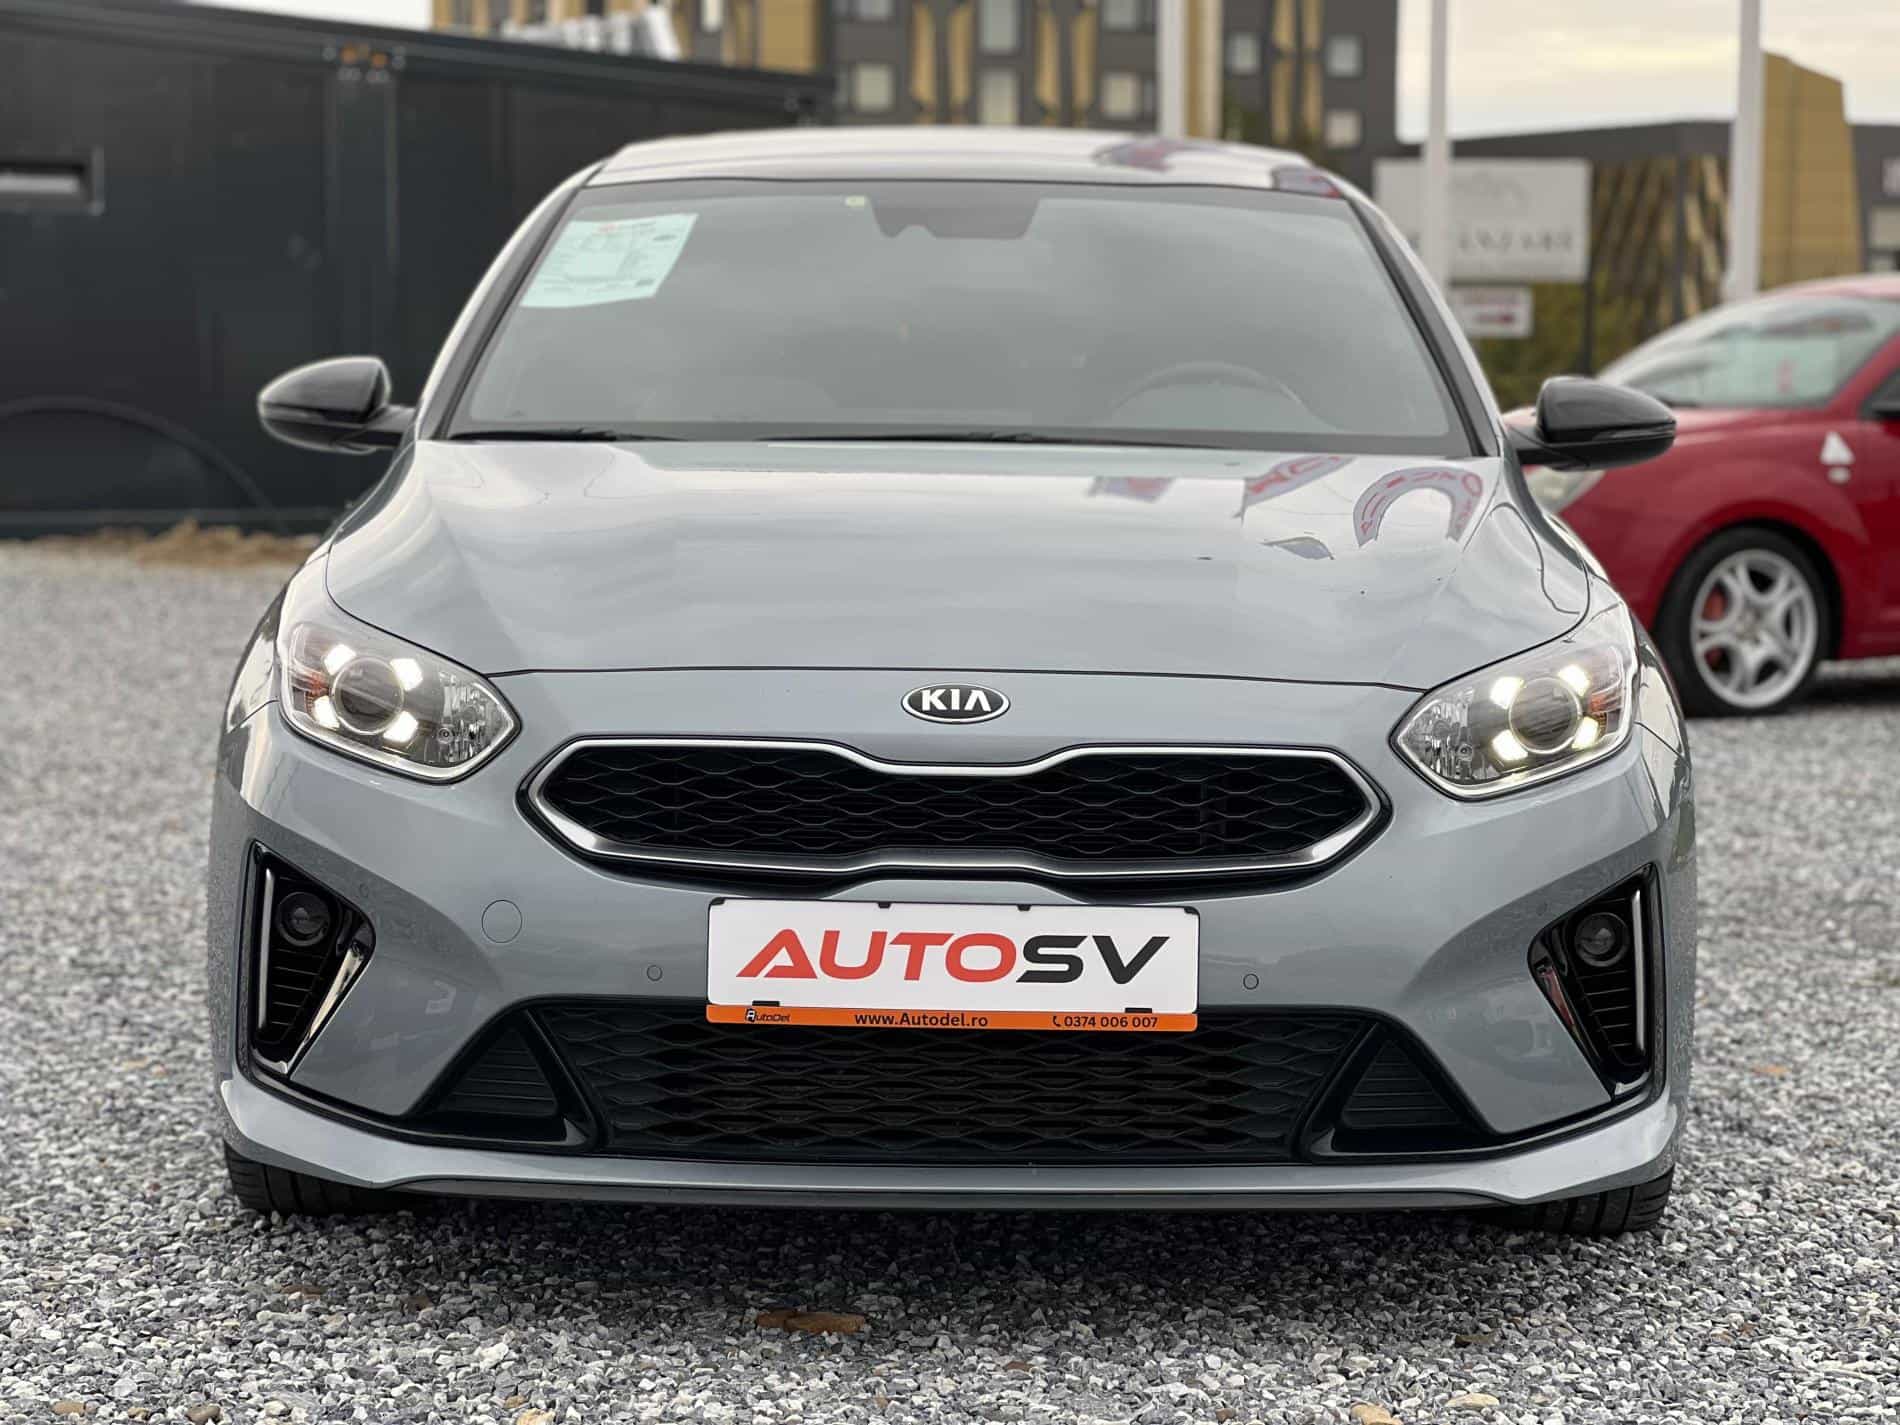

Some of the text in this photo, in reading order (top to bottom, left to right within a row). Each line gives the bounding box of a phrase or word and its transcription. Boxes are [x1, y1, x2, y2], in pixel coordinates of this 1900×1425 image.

[921, 688, 992, 712] KIA
[736, 928, 1170, 984] AUTOSV
[854, 1012, 989, 1027] www.Autodel.ro
[1063, 1015, 1158, 1028] 0374 006 007
